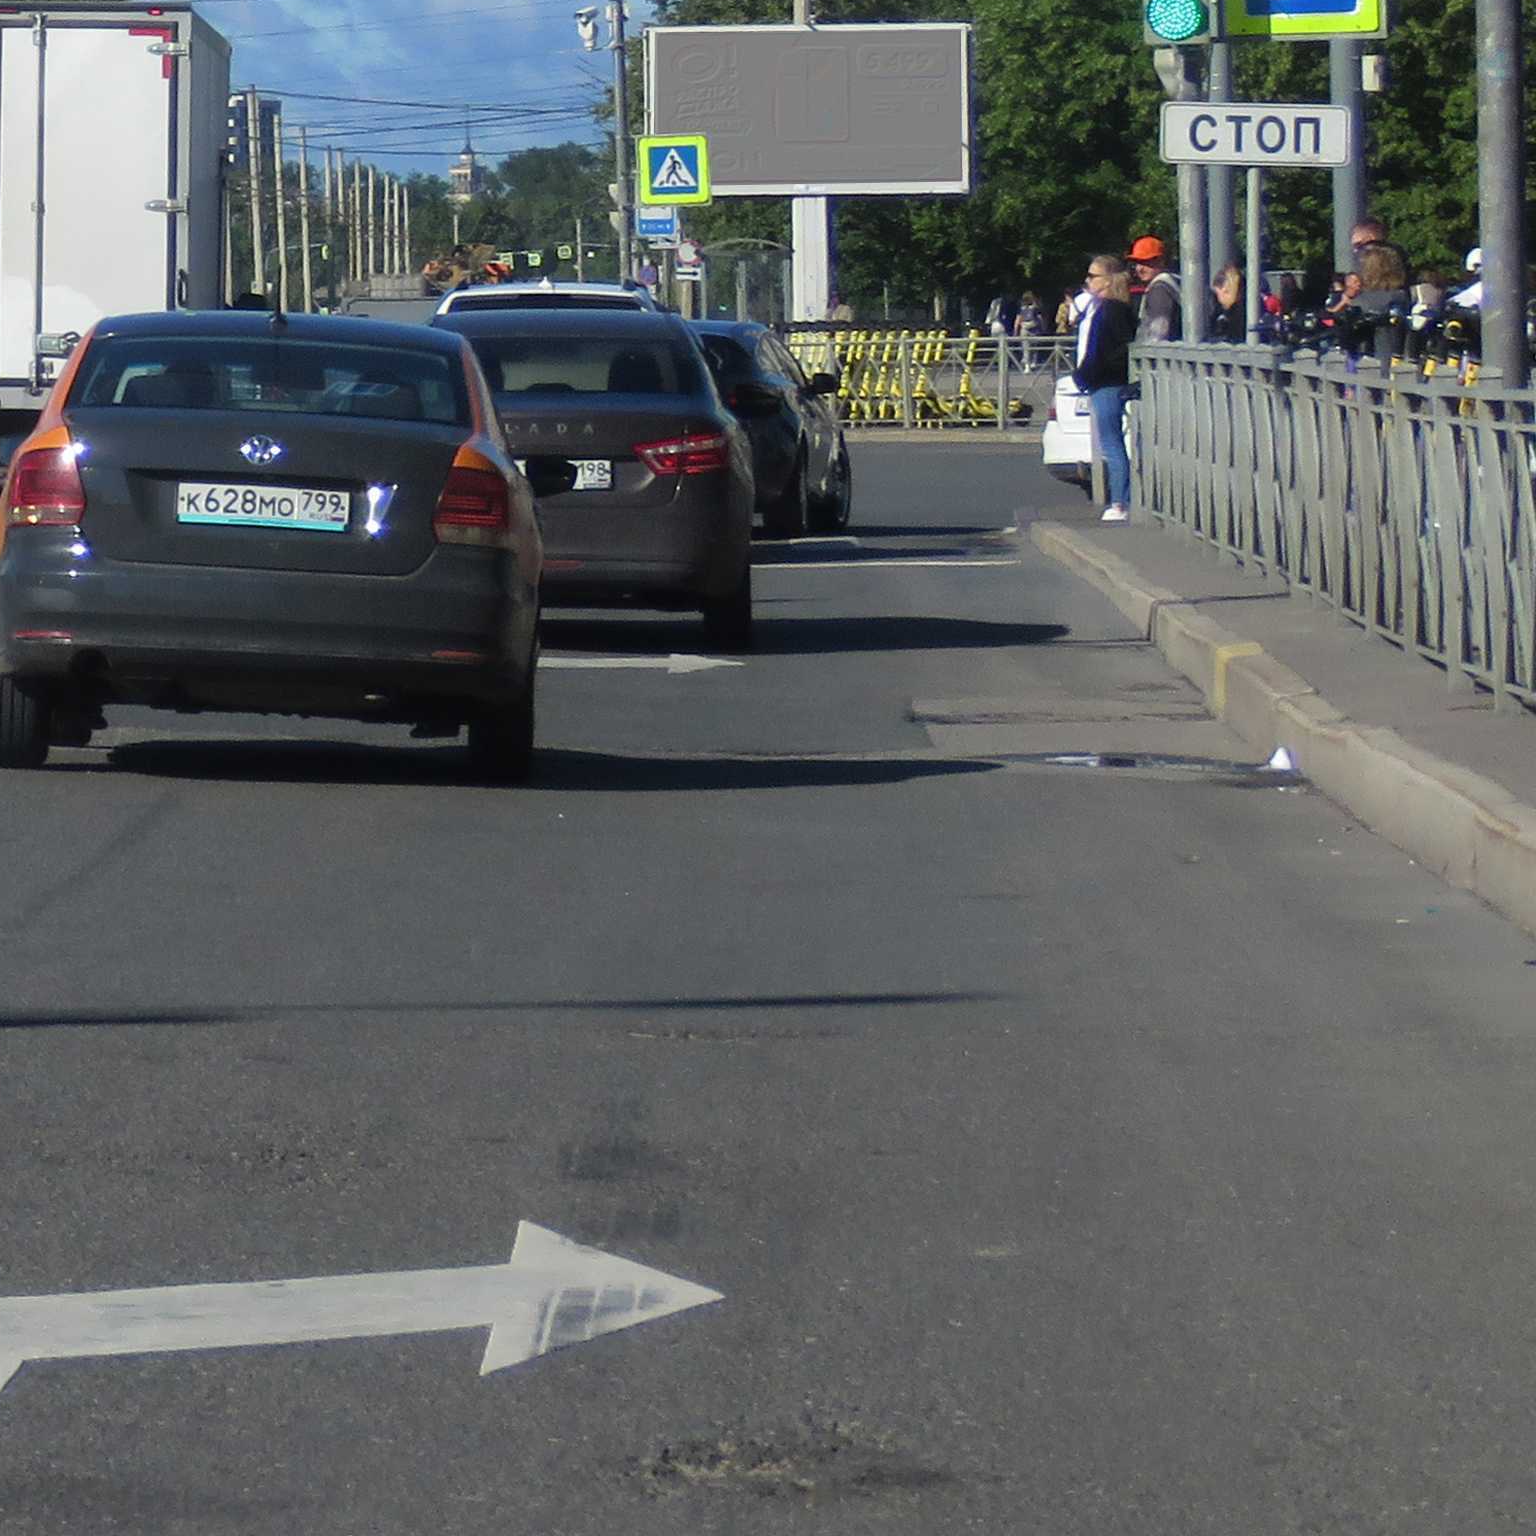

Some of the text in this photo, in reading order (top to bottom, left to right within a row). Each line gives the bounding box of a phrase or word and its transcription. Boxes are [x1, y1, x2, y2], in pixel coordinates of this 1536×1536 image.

[1189, 113, 1321, 154] СТОП
[504, 424, 594, 435] LADA
[577, 462, 607, 476] 198
[186, 488, 341, 518] К628МО 799
